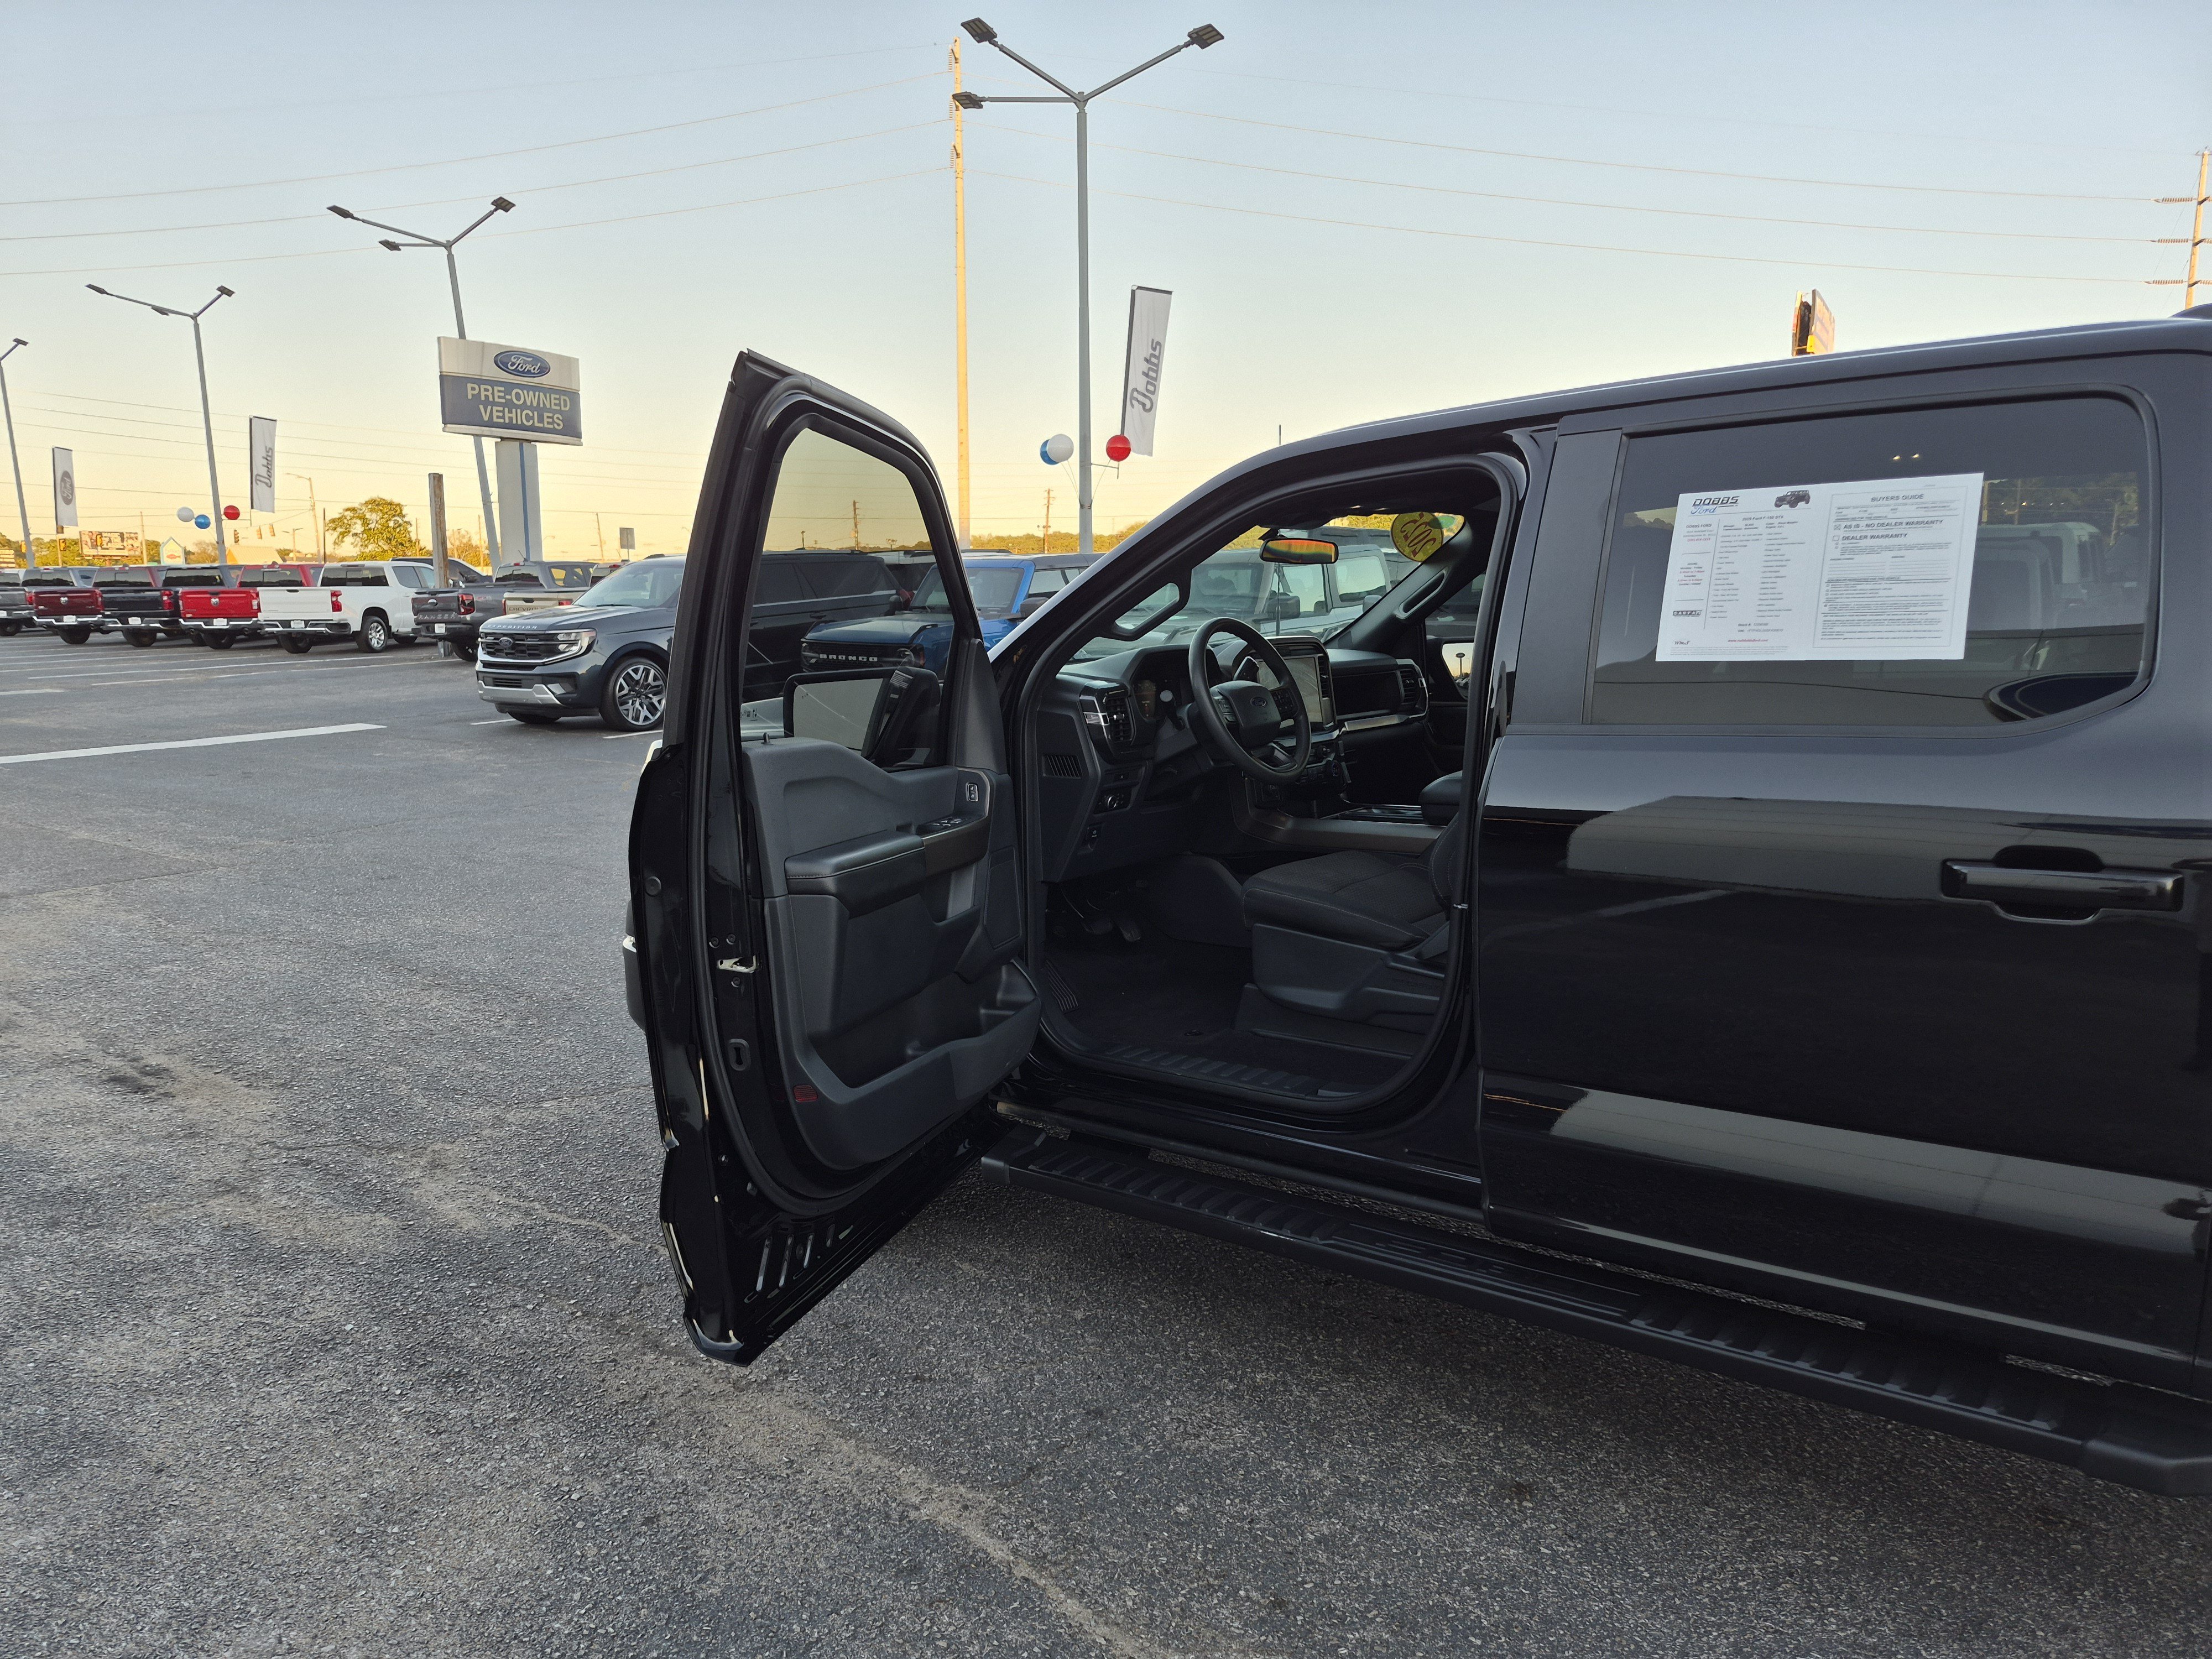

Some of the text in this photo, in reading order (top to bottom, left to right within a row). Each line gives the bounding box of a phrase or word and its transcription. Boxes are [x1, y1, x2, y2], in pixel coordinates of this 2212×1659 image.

[508, 354, 540, 374] Ford
[1129, 338, 1162, 413] Dobbs
[467, 383, 570, 411] PRE-OWNED
[479, 405, 564, 430] VEHICLES
[255, 446, 273, 488] Dobbs
[62, 477, 72, 499] Ford
[1691, 505, 1717, 514] Ford
[1692, 496, 1739, 506] DOBBS
[820, 654, 878, 662] BRONCO
